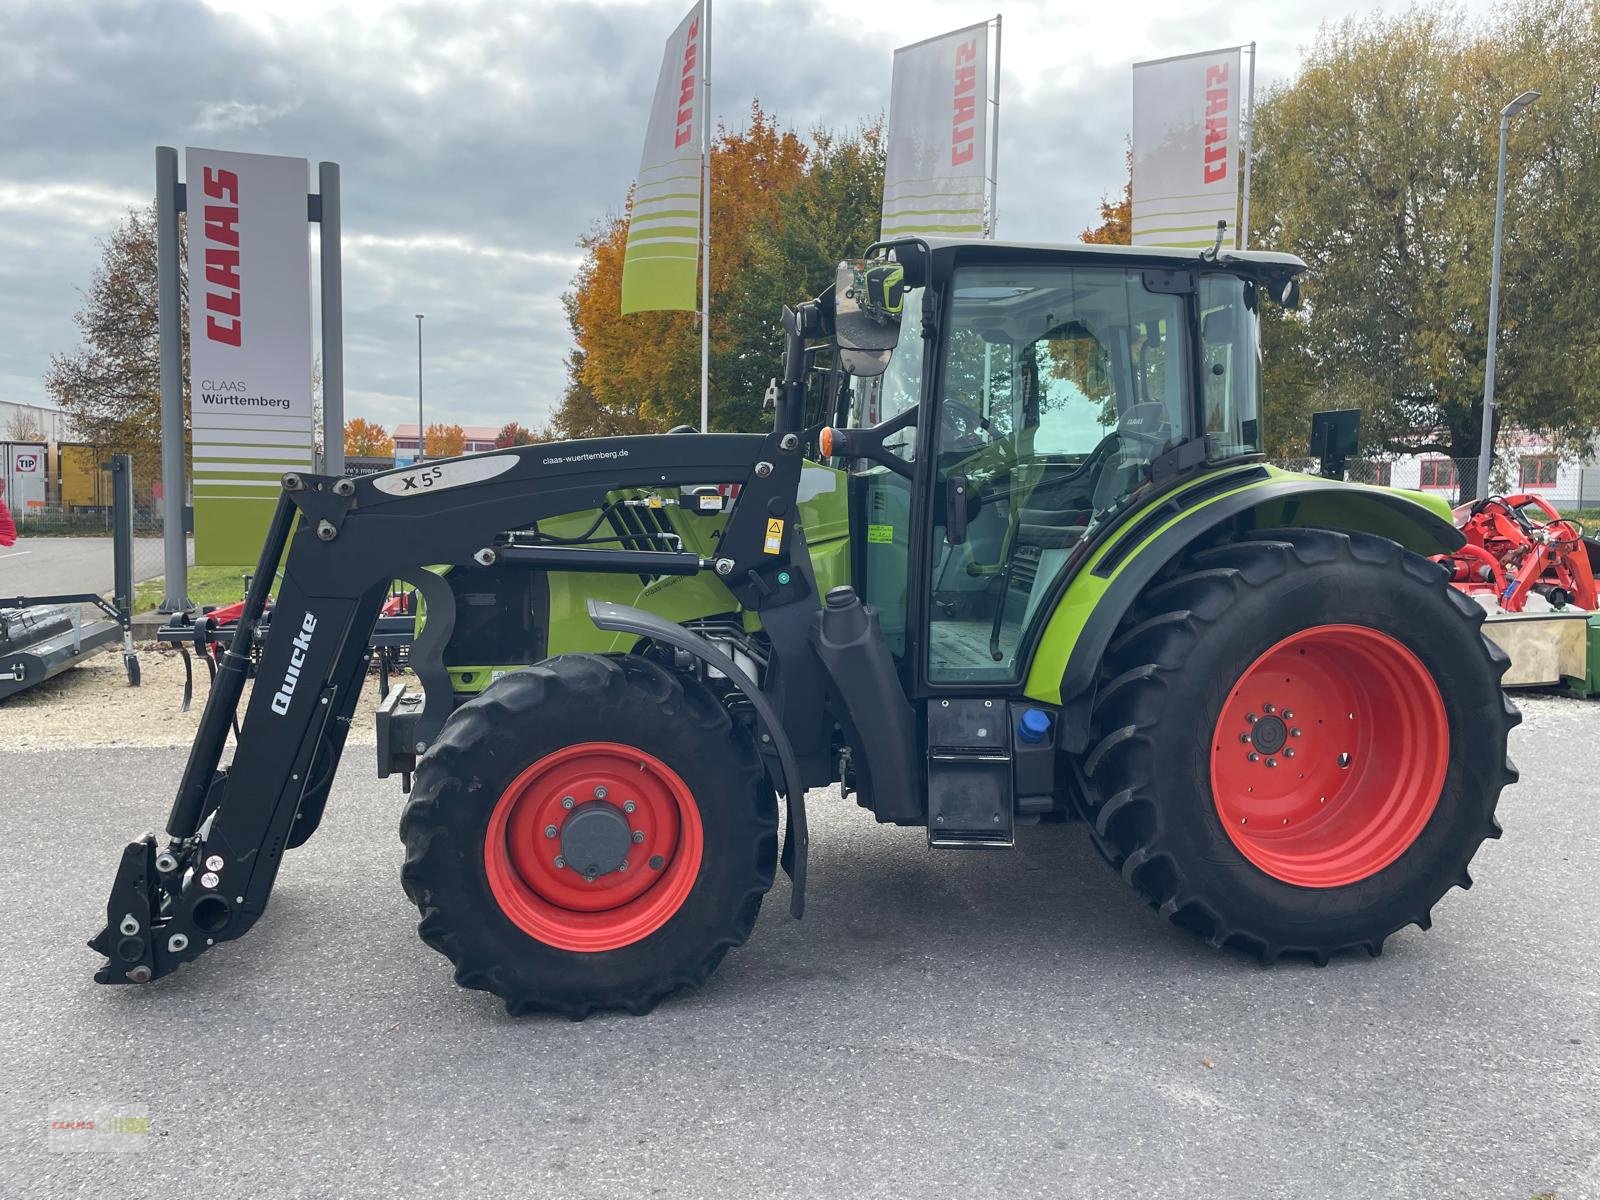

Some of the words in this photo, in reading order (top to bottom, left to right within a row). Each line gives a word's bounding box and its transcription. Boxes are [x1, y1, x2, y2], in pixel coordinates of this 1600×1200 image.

[203, 166, 241, 347] CLAAS
[201, 379, 247, 392] CLAAS
[201, 393, 290, 410] Württemberg
[19, 459, 35, 468] TIP
[542, 448, 629, 465] claas-wuerttemberg.de
[271, 610, 318, 716] Quicke
